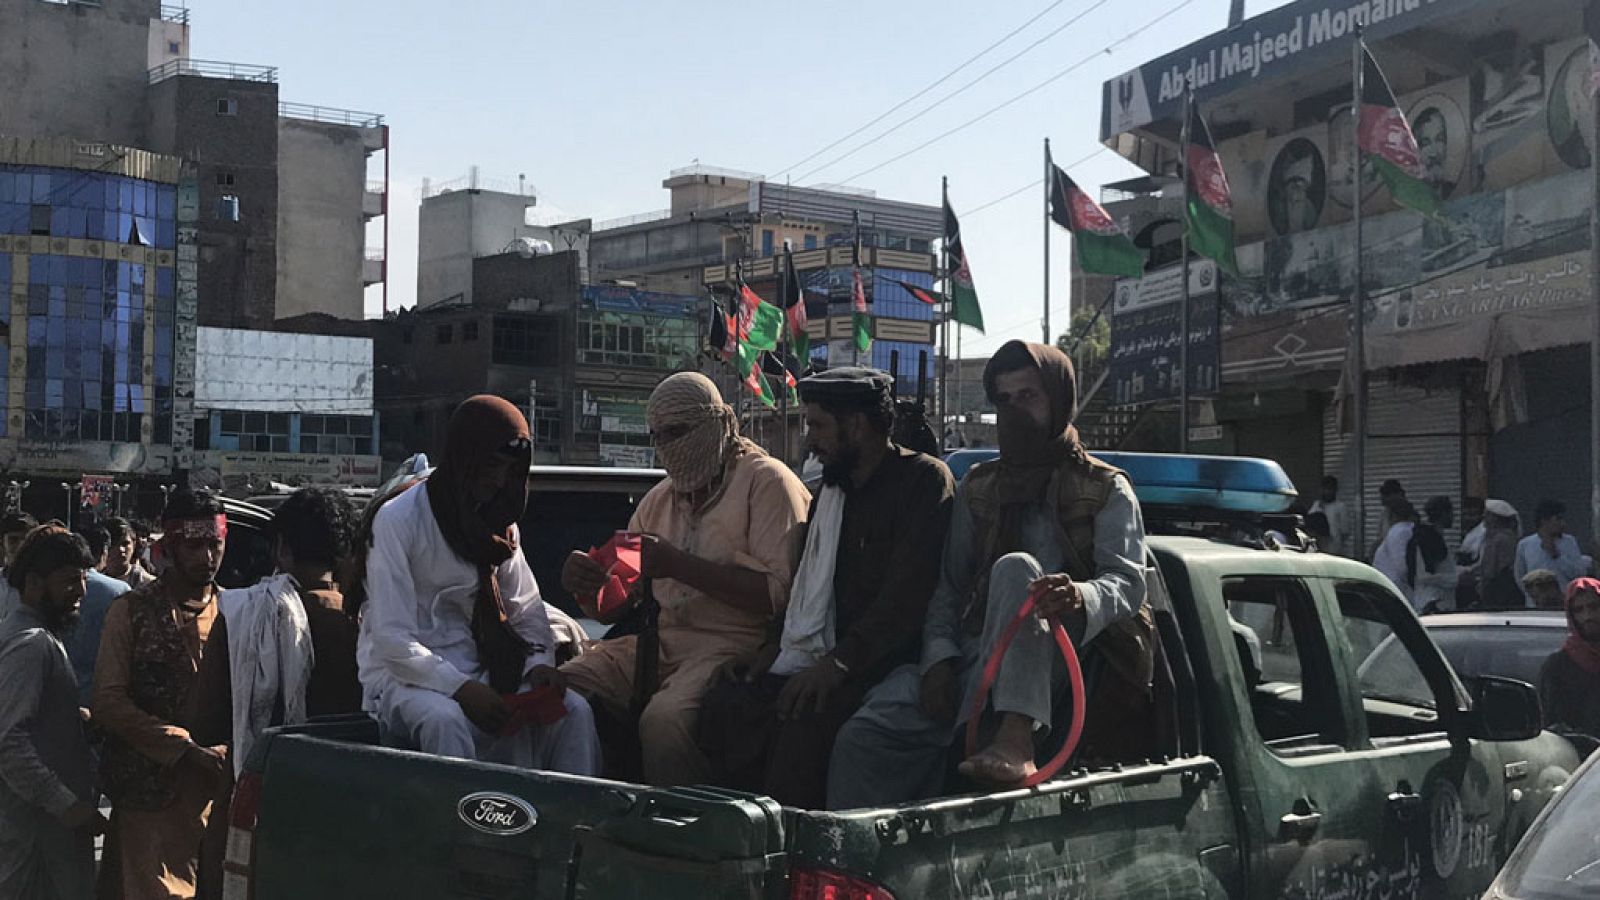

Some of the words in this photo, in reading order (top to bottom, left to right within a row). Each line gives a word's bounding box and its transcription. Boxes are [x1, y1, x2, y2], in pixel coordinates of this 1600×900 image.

[1158, 51, 1216, 103] Abdul
[1219, 16, 1303, 78] Majeed
[474, 799, 517, 826] Ford
